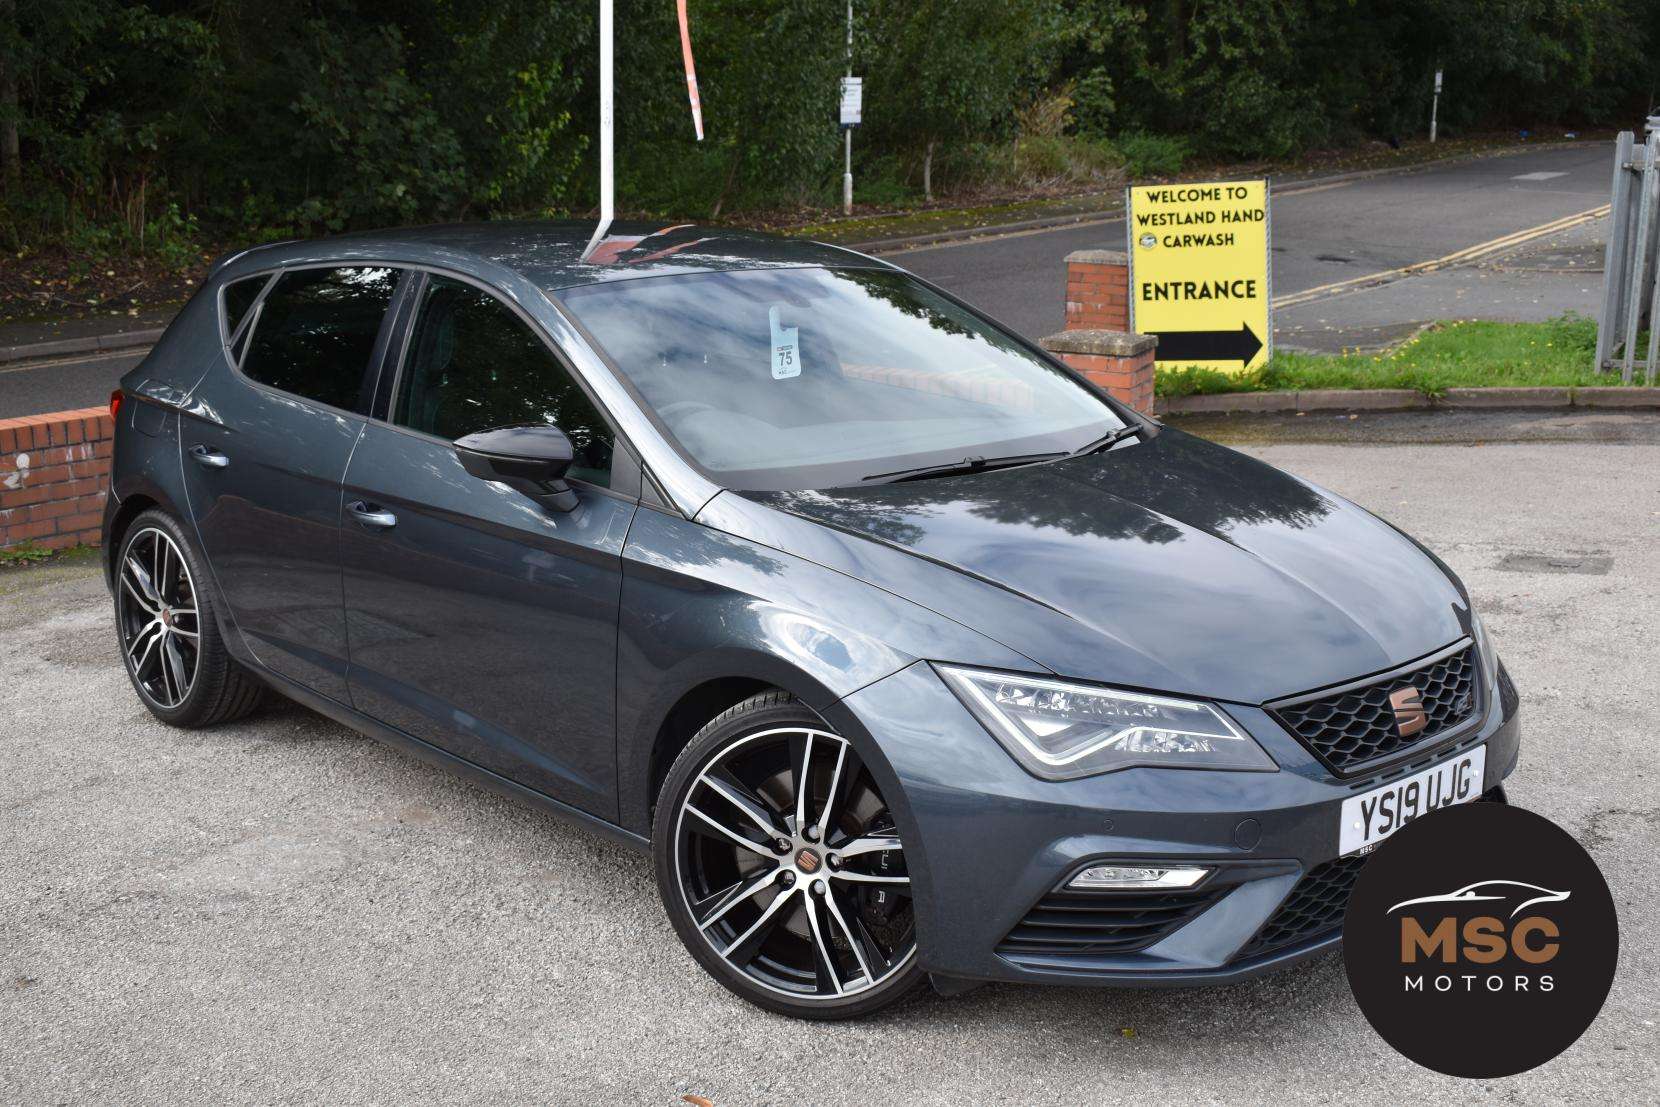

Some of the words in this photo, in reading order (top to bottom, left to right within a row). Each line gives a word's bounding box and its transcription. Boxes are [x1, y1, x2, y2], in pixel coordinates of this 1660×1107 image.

[1147, 187, 1221, 203] WELCOME
[1226, 186, 1248, 200] TO
[1137, 211, 1216, 226] WESTLAND
[1222, 209, 1264, 224] HAND
[1163, 233, 1234, 248] CARWASH
[1142, 280, 1256, 301] ENTRANCE
[778, 351, 793, 367] 75
[1361, 781, 1420, 841] YS19
[1426, 758, 1472, 813] UJG
